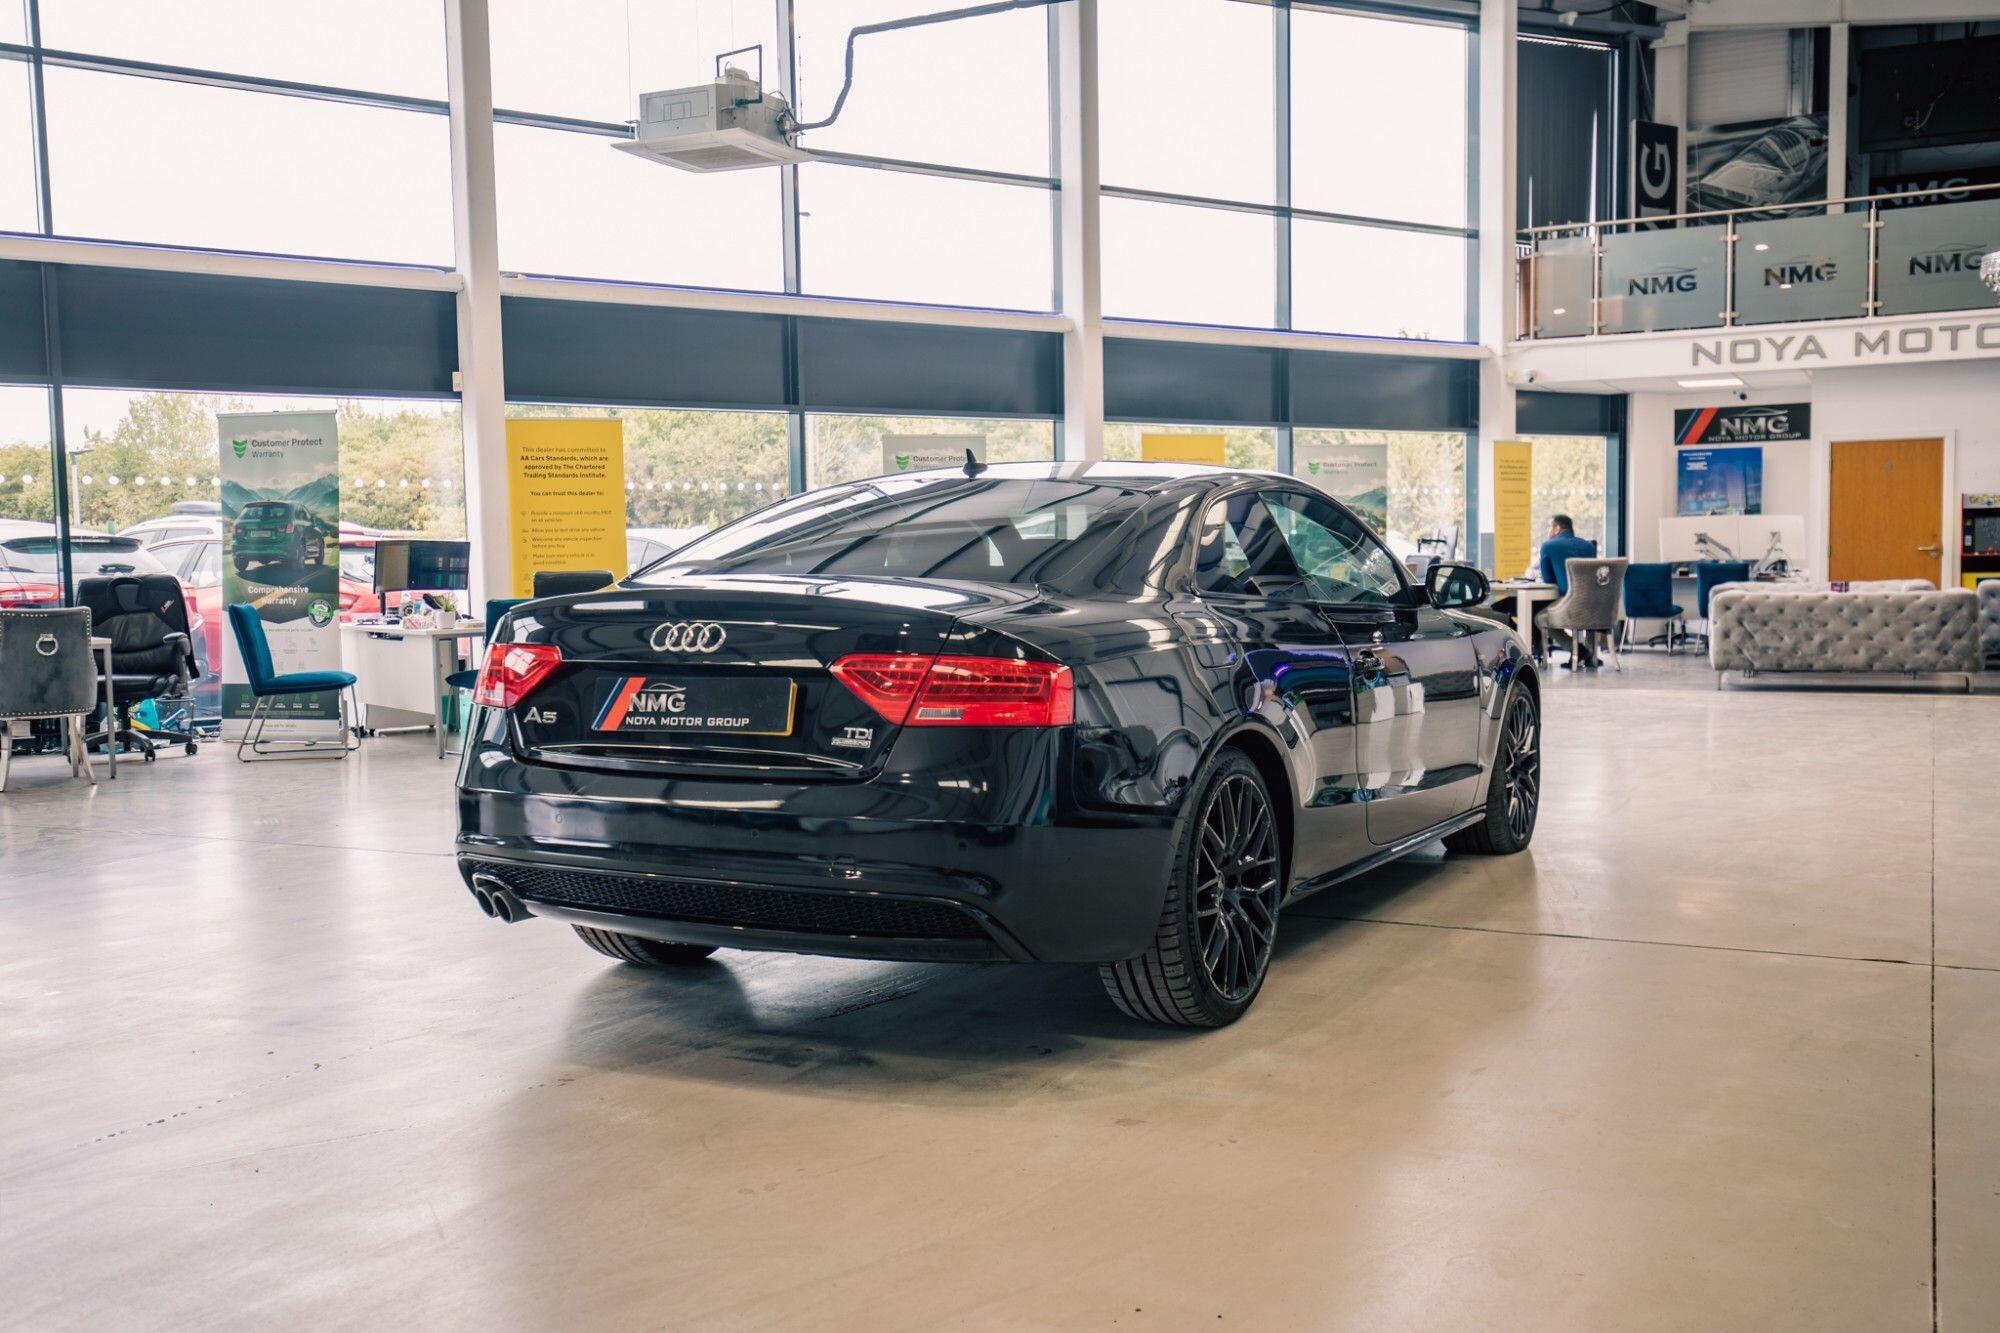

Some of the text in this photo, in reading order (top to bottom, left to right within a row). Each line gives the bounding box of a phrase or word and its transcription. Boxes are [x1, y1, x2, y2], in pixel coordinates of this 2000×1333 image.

[1876, 178, 1970, 206] NMG
[1908, 250, 1986, 276] NMG
[1763, 262, 1839, 286] NMG
[1628, 273, 1698, 296] NMG
[1691, 322, 2000, 367] NOYA MOTO
[1720, 415, 1789, 436] NMG
[251, 437, 323, 448] Customer Protect
[251, 450, 284, 459] Warranty
[247, 585, 309, 594] Comprehensive
[627, 693, 687, 713] NMG
[523, 706, 557, 724] A5
[625, 715, 750, 728] NOYA MOTOR GROUP
[843, 726, 874, 740] TDI
